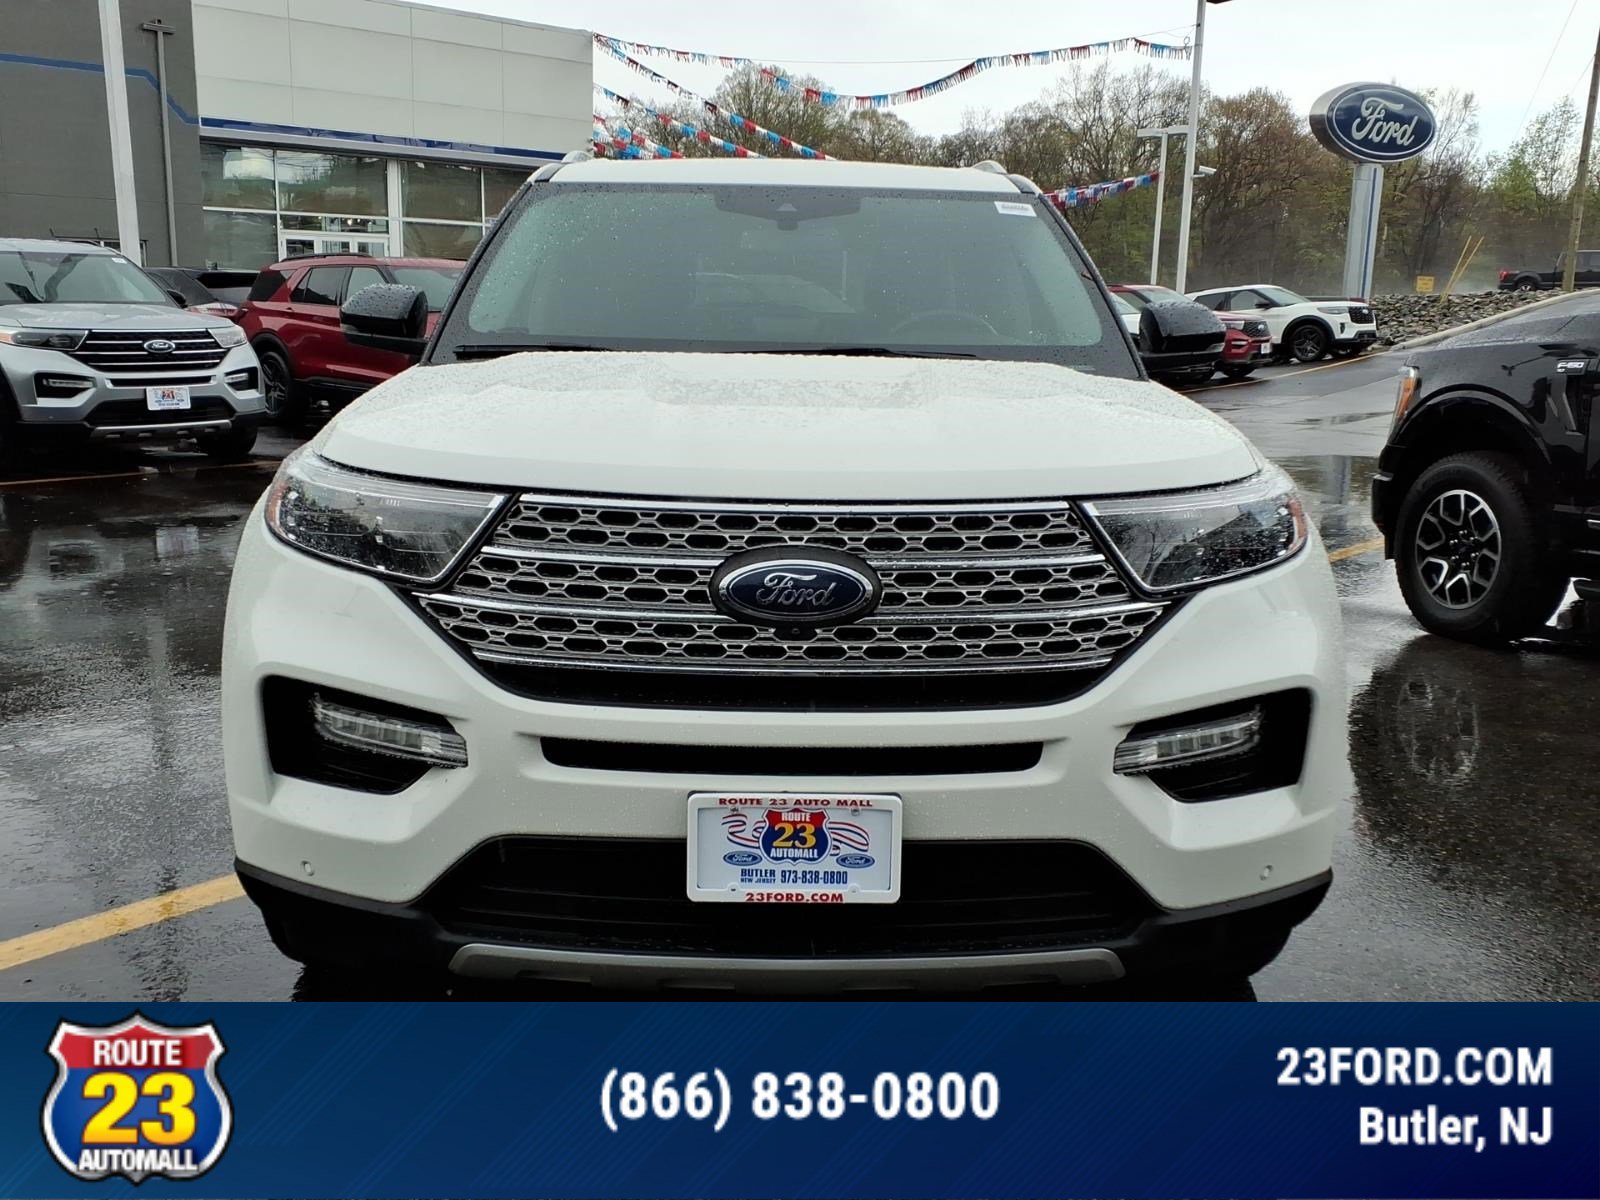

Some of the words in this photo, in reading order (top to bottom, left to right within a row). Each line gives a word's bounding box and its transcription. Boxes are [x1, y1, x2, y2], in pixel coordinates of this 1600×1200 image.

[1352, 97, 1418, 147] Ford
[756, 572, 836, 606] Ford
[719, 798, 762, 806] ROUTE
[769, 798, 787, 806] 23
[793, 799, 830, 807] AUTO
[836, 799, 873, 807] MALL
[781, 812, 811, 822] ROUTE
[772, 822, 817, 849] 23
[770, 848, 819, 859] AUTOMALL
[740, 868, 776, 878] BUTLER
[780, 869, 848, 885] 973-838-0800
[745, 892, 845, 903] 23FORD.COM
